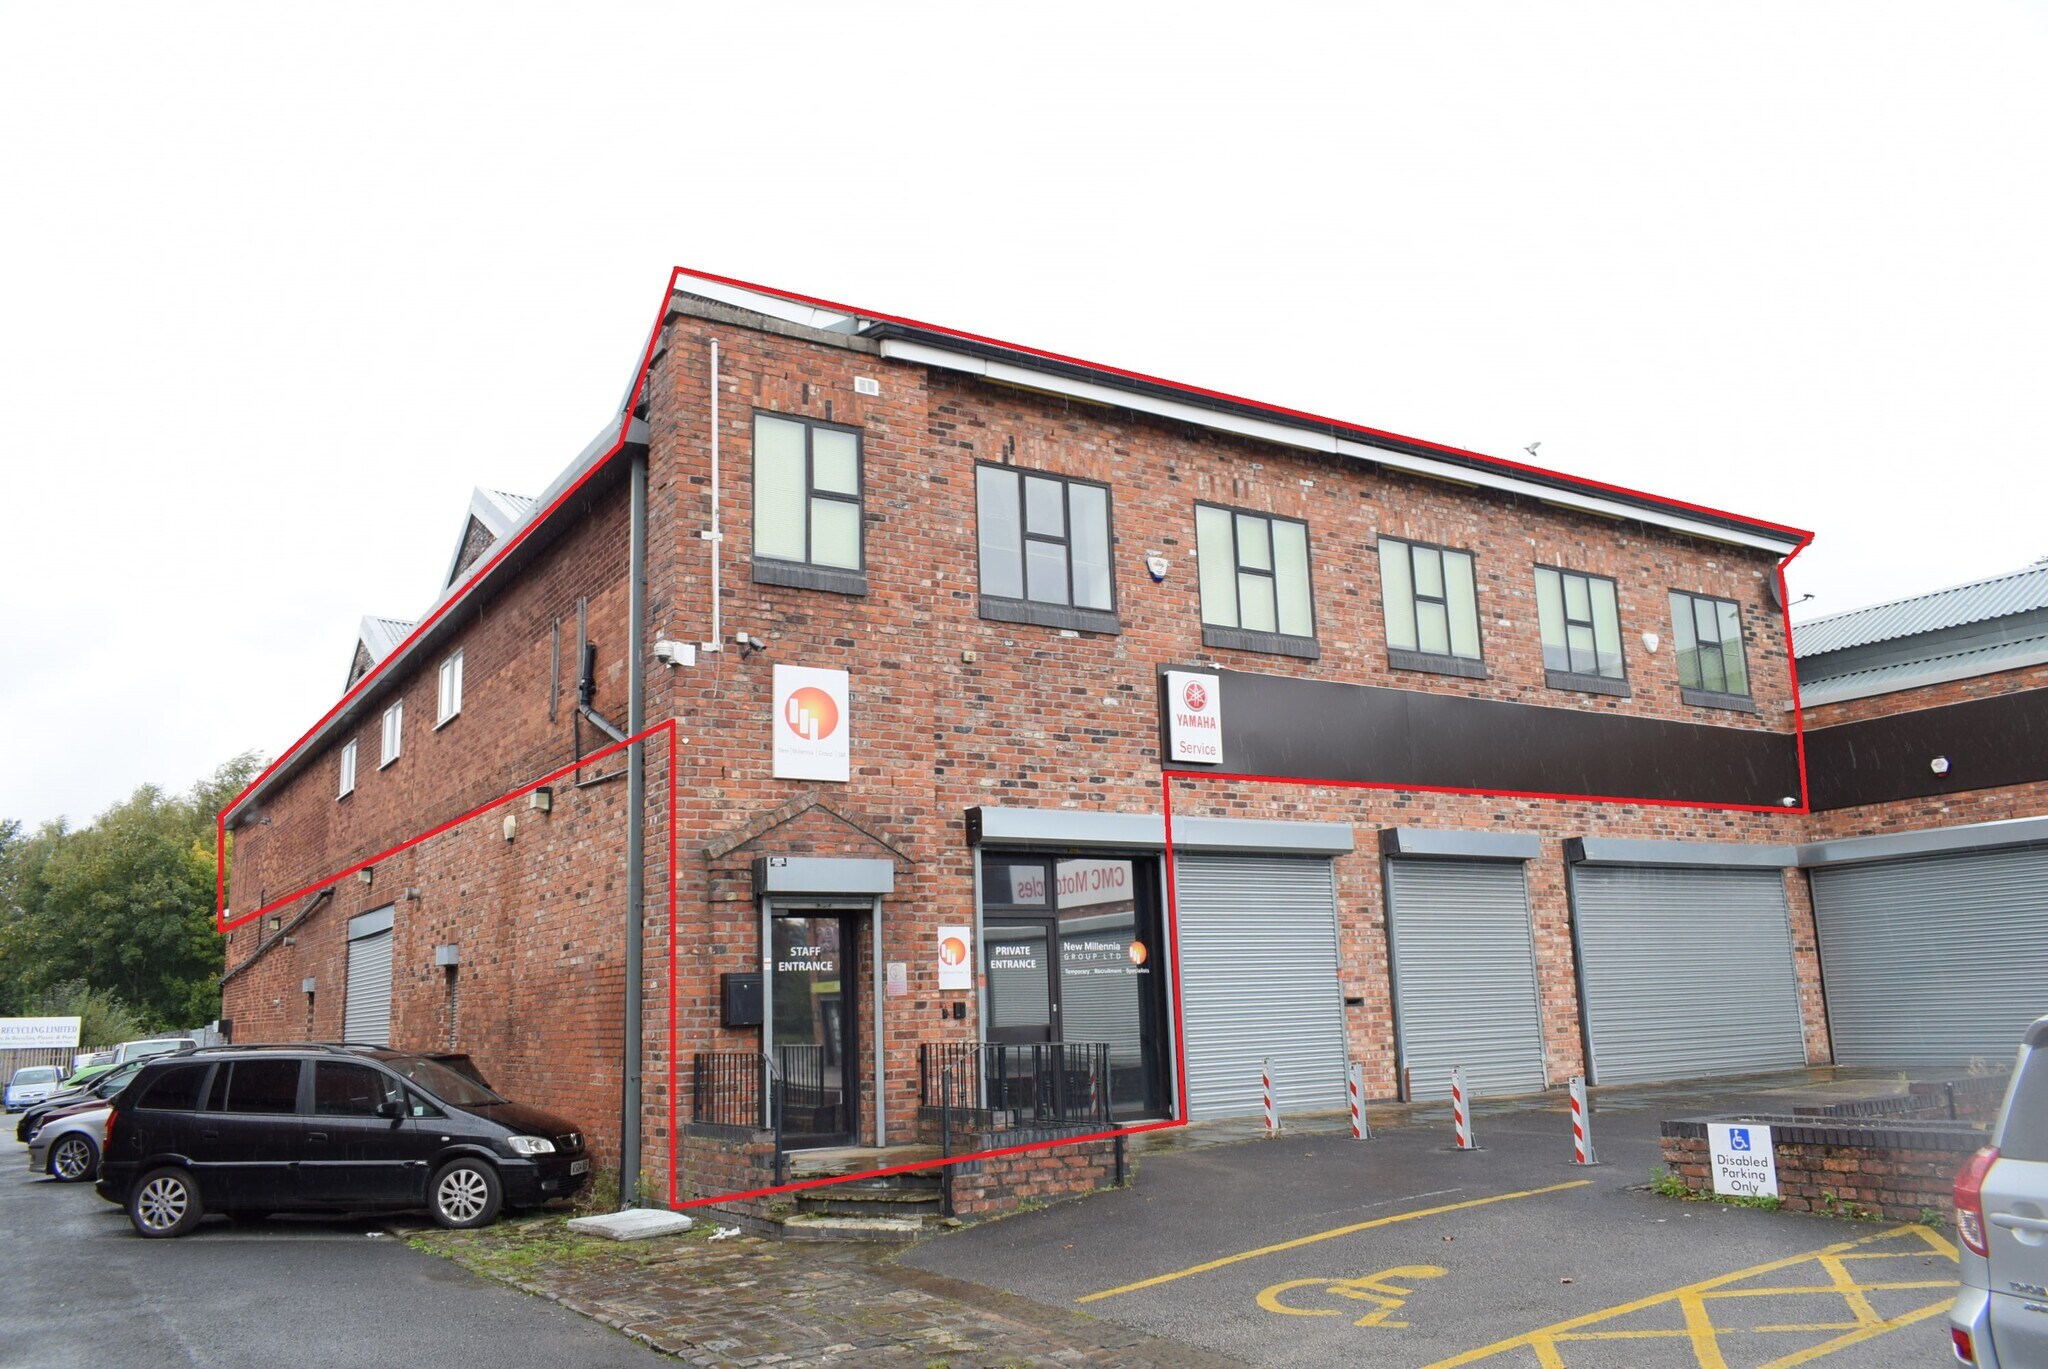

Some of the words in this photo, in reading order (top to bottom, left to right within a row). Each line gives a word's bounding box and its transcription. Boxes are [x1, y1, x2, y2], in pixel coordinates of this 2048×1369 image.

[1176, 713, 1216, 729] YAMAHA
[1179, 740, 1216, 756] Service
[789, 946, 821, 957] STAFF
[995, 946, 1031, 956] PRIVATE
[1063, 942, 1083, 951] New
[1084, 942, 1121, 951] Millennia
[778, 961, 833, 972] ENTRANCE
[990, 959, 1037, 969] ENTRANCE
[1, 1026, 44, 1034] RECYCLING
[1717, 1154, 1768, 1168] Disabled
[1722, 1167, 1766, 1183] Parking
[1731, 1180, 1759, 1195] Only
